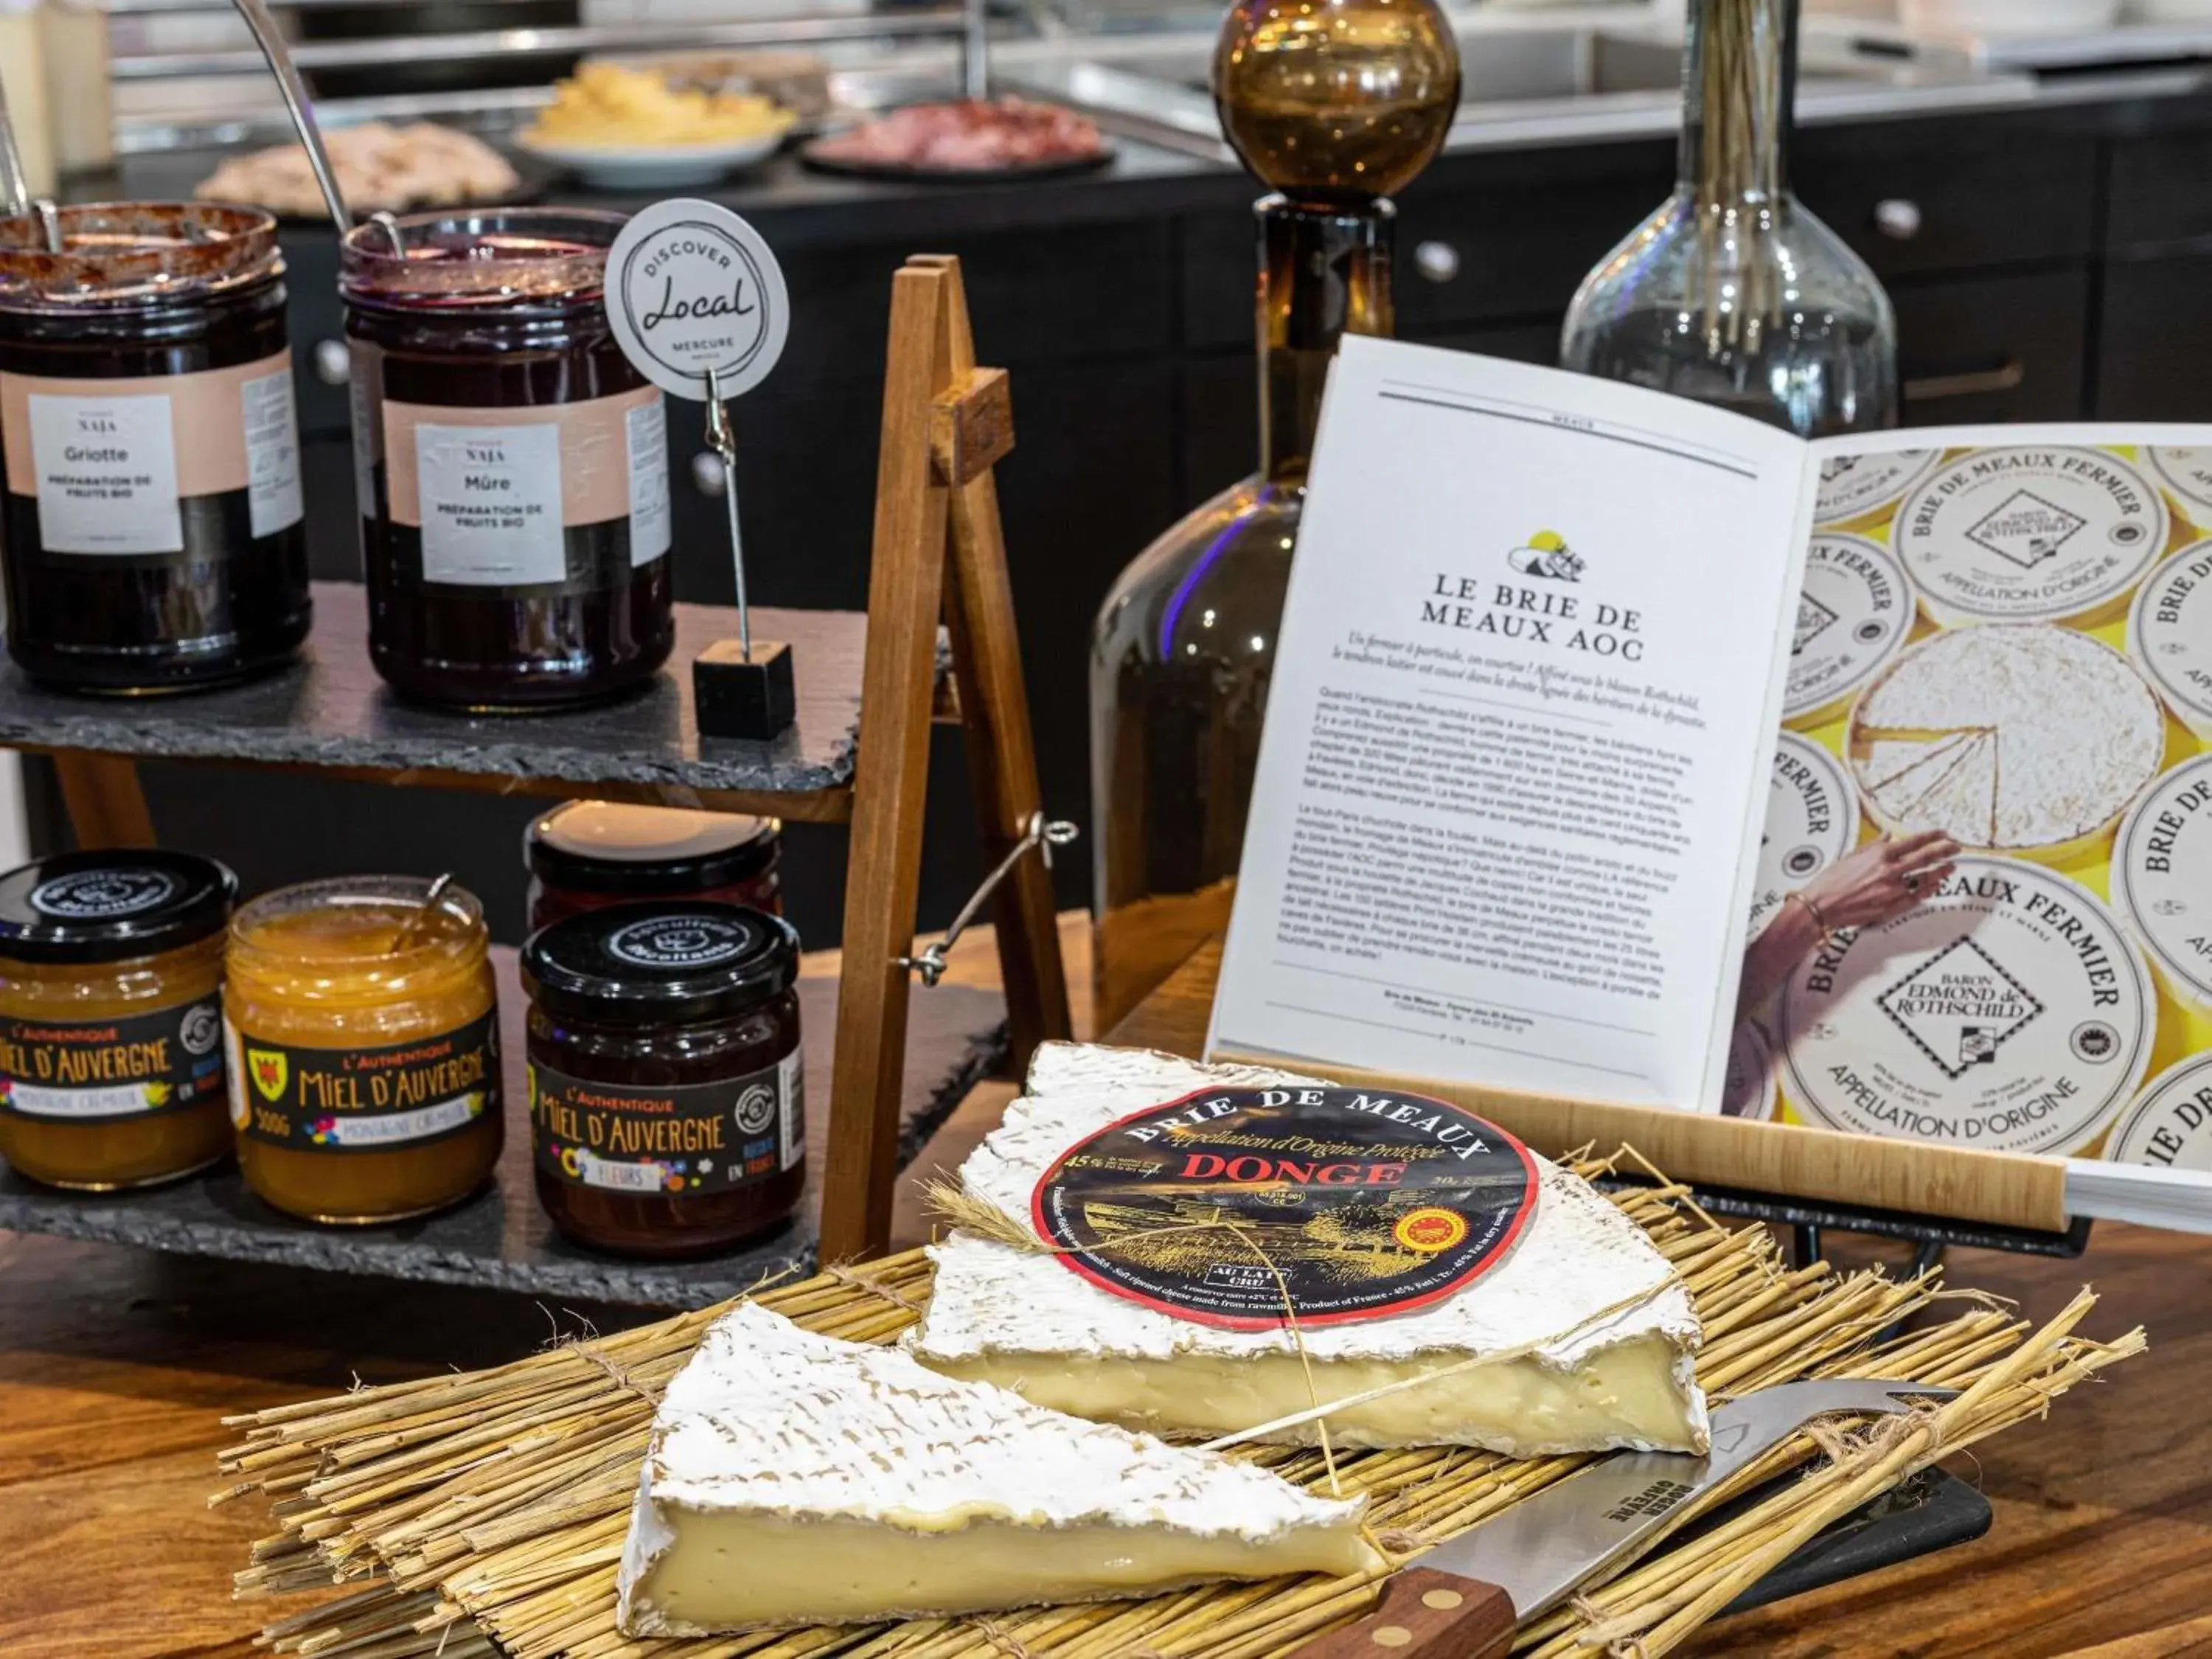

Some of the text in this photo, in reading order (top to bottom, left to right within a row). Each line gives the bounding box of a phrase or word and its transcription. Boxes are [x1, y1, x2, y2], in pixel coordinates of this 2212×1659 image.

[644, 241, 731, 277] DISCOVER
[644, 275, 754, 330] Local
[672, 338, 734, 352] MERCURE
[64, 445, 129, 462] Griotte
[465, 473, 510, 490] Mûre
[1912, 495, 1944, 537] BRIE
[1938, 473, 1971, 495] DE
[1971, 453, 2058, 476] MEAUX
[2062, 456, 2142, 515] FERMIER
[1434, 574, 1642, 633] LE BRIE DE
[1833, 549, 1893, 612] FERMIER
[2157, 576, 2196, 624] BRIE
[1420, 600, 1646, 662] MEAUX AOC
[1774, 751, 1830, 836] FERMIER
[2146, 779, 2212, 874] BRIE DE
[1806, 876, 2120, 1008] BRIE EAUX FERMIER
[1907, 984, 2021, 1003] EDMOND de
[1941, 973, 1992, 985] BARON
[1896, 998, 2025, 1019] ROTHSCHILD
[34, 1037, 173, 1083] D'AUVERGNE
[298, 1045, 485, 1109] MIEL D'AUVERGNE
[540, 1088, 582, 1143] MIEL
[588, 1112, 727, 1153] D'AUVERGNE
[1827, 1064, 1958, 1138] APPELLATION
[1965, 1075, 2081, 1138] D'ORIGINE
[1124, 1090, 1492, 1161] BRIE DE MEAUX
[1162, 1129, 1268, 1149] Appellation
[1270, 1134, 1365, 1158] d'Origine
[1178, 1153, 1408, 1186] DONGE
[1132, 1277, 1163, 1292] ripened
[1162, 1287, 1192, 1301] cheese
[1192, 1295, 1219, 1306] made
[1221, 1299, 1246, 1309] from
[1300, 1300, 1340, 1310] Product
[1354, 1293, 1387, 1304] France
[1214, 1267, 1237, 1276] AU
[1229, 1276, 1265, 1287] CRU
